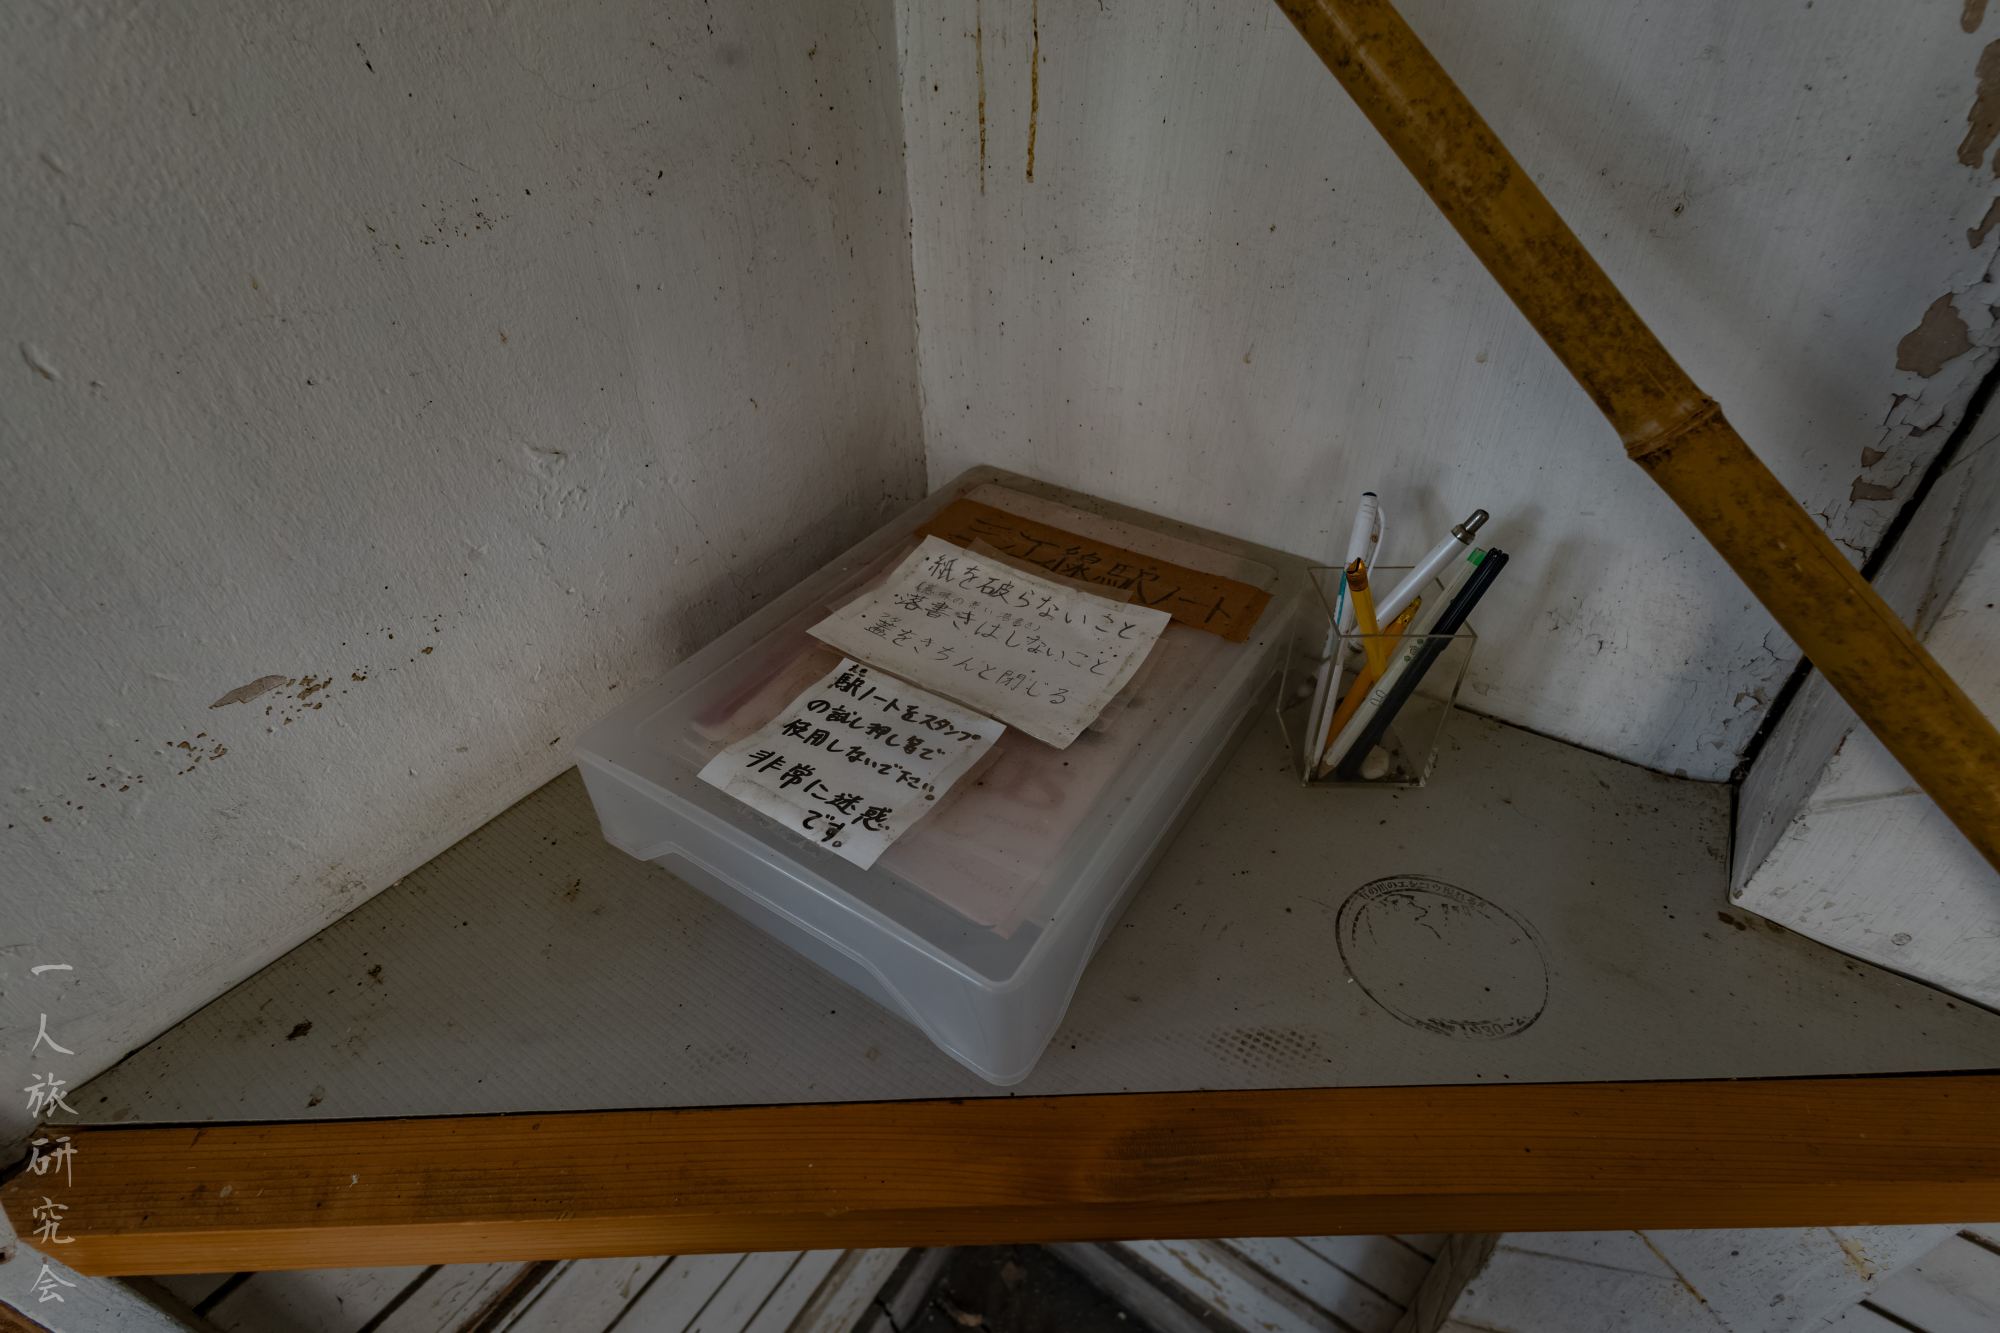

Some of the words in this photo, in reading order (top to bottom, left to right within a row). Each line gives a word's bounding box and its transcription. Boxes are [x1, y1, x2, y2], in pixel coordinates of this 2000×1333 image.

[834, 672, 982, 742] 駅ノートをスタンプ
[746, 750, 892, 832] 非常に迷惑
[803, 810, 846, 847] です。
